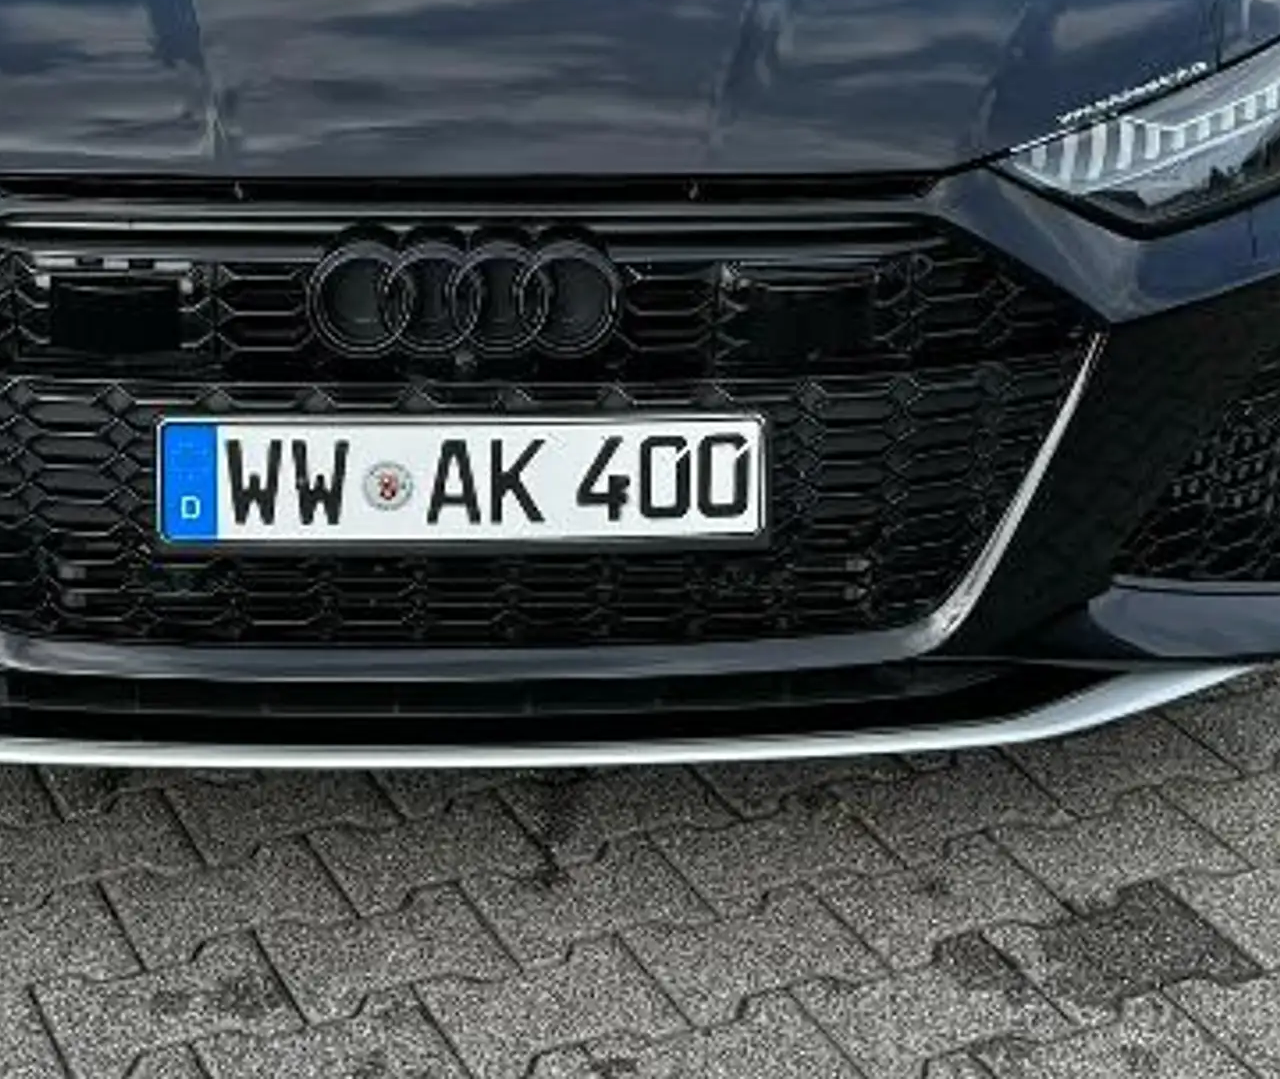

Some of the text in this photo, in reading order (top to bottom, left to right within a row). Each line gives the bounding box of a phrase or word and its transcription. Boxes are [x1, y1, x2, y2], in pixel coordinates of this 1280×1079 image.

[180, 495, 202, 520] D
[225, 434, 751, 525] WW AK 400
